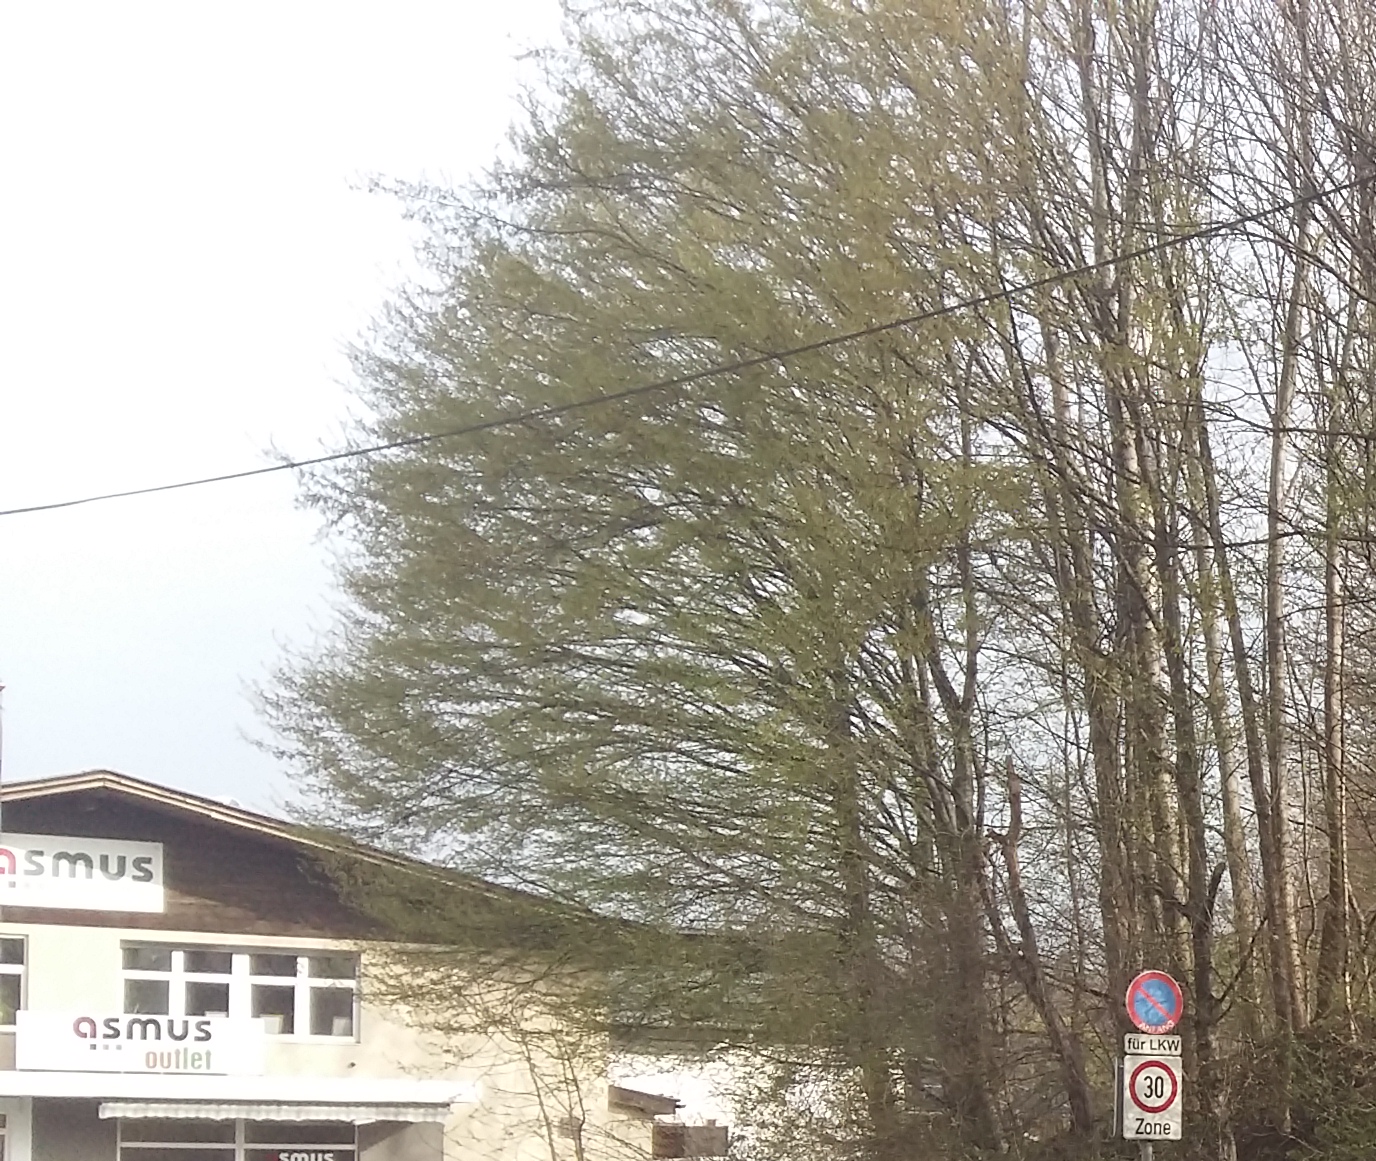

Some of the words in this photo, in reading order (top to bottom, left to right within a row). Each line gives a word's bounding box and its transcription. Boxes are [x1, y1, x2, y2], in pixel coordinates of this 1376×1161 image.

[73, 1016, 212, 1042] asmus
[1128, 1038, 1146, 1050] für
[1150, 1039, 1180, 1051] LKW
[145, 1047, 212, 1070] outlet
[1143, 1075, 1164, 1099] 30
[1135, 1118, 1171, 1135] Zone
